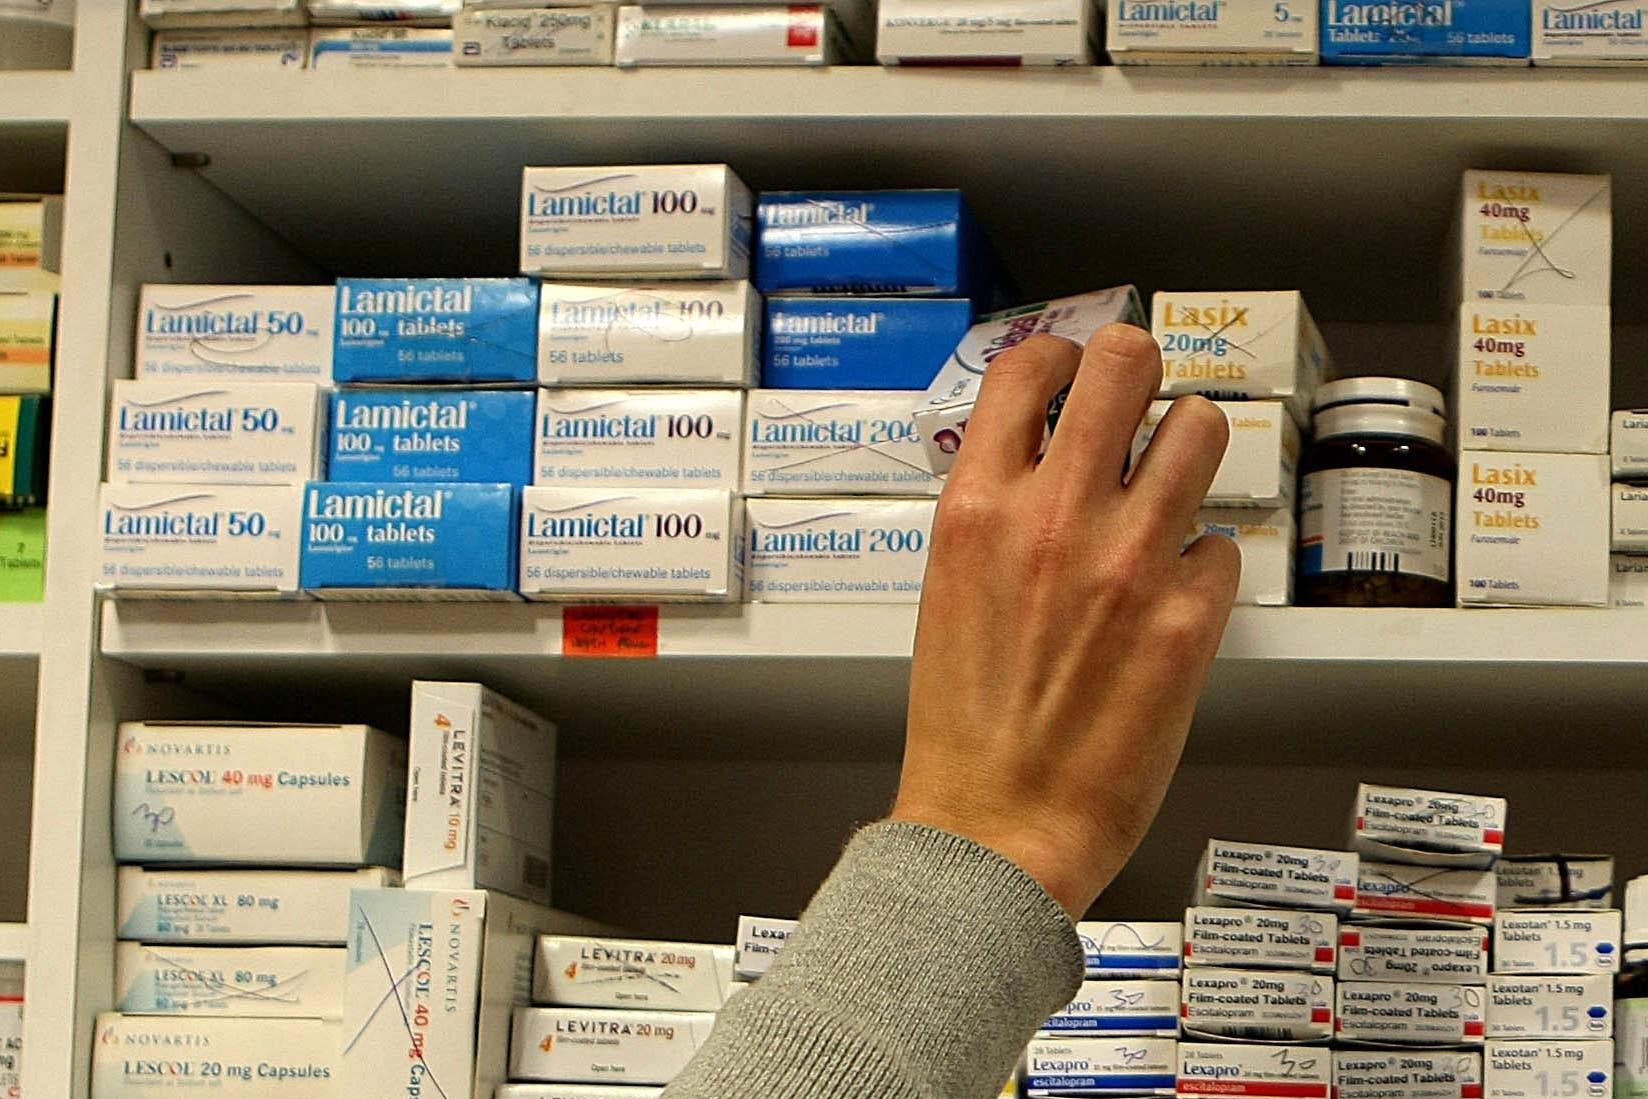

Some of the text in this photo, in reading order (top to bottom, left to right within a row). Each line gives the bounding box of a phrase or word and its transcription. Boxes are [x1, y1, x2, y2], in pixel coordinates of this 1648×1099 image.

[1543, 9, 1642, 30] Lamictal
[528, 189, 697, 217] Lamictal 100
[1164, 300, 1248, 329] Lasix
[1473, 314, 1536, 335] Lasix
[1163, 334, 1227, 356] 20mg
[1473, 337, 1525, 357] 40mg
[1474, 359, 1539, 378] Tablets
[308, 489, 443, 519] Lamictal
[105, 510, 265, 537] Lamictal 50
[309, 525, 435, 543] 100 tablets
[751, 528, 924, 553] Lamictal 200
[367, 555, 434, 570] 56 tablets
[149, 744, 231, 755] NOVARTIS
[147, 770, 349, 789] LESCOL 40 mg Capsules
[1257, 918, 1289, 931] 20mg
[1555, 921, 1570, 931] 1.5
[1572, 922, 1591, 933] mg
[1194, 931, 1310, 946] Film-coated Tablets
[1502, 931, 1541, 942] Tablets
[557, 1020, 674, 1040] LEVITRA 20 mg
